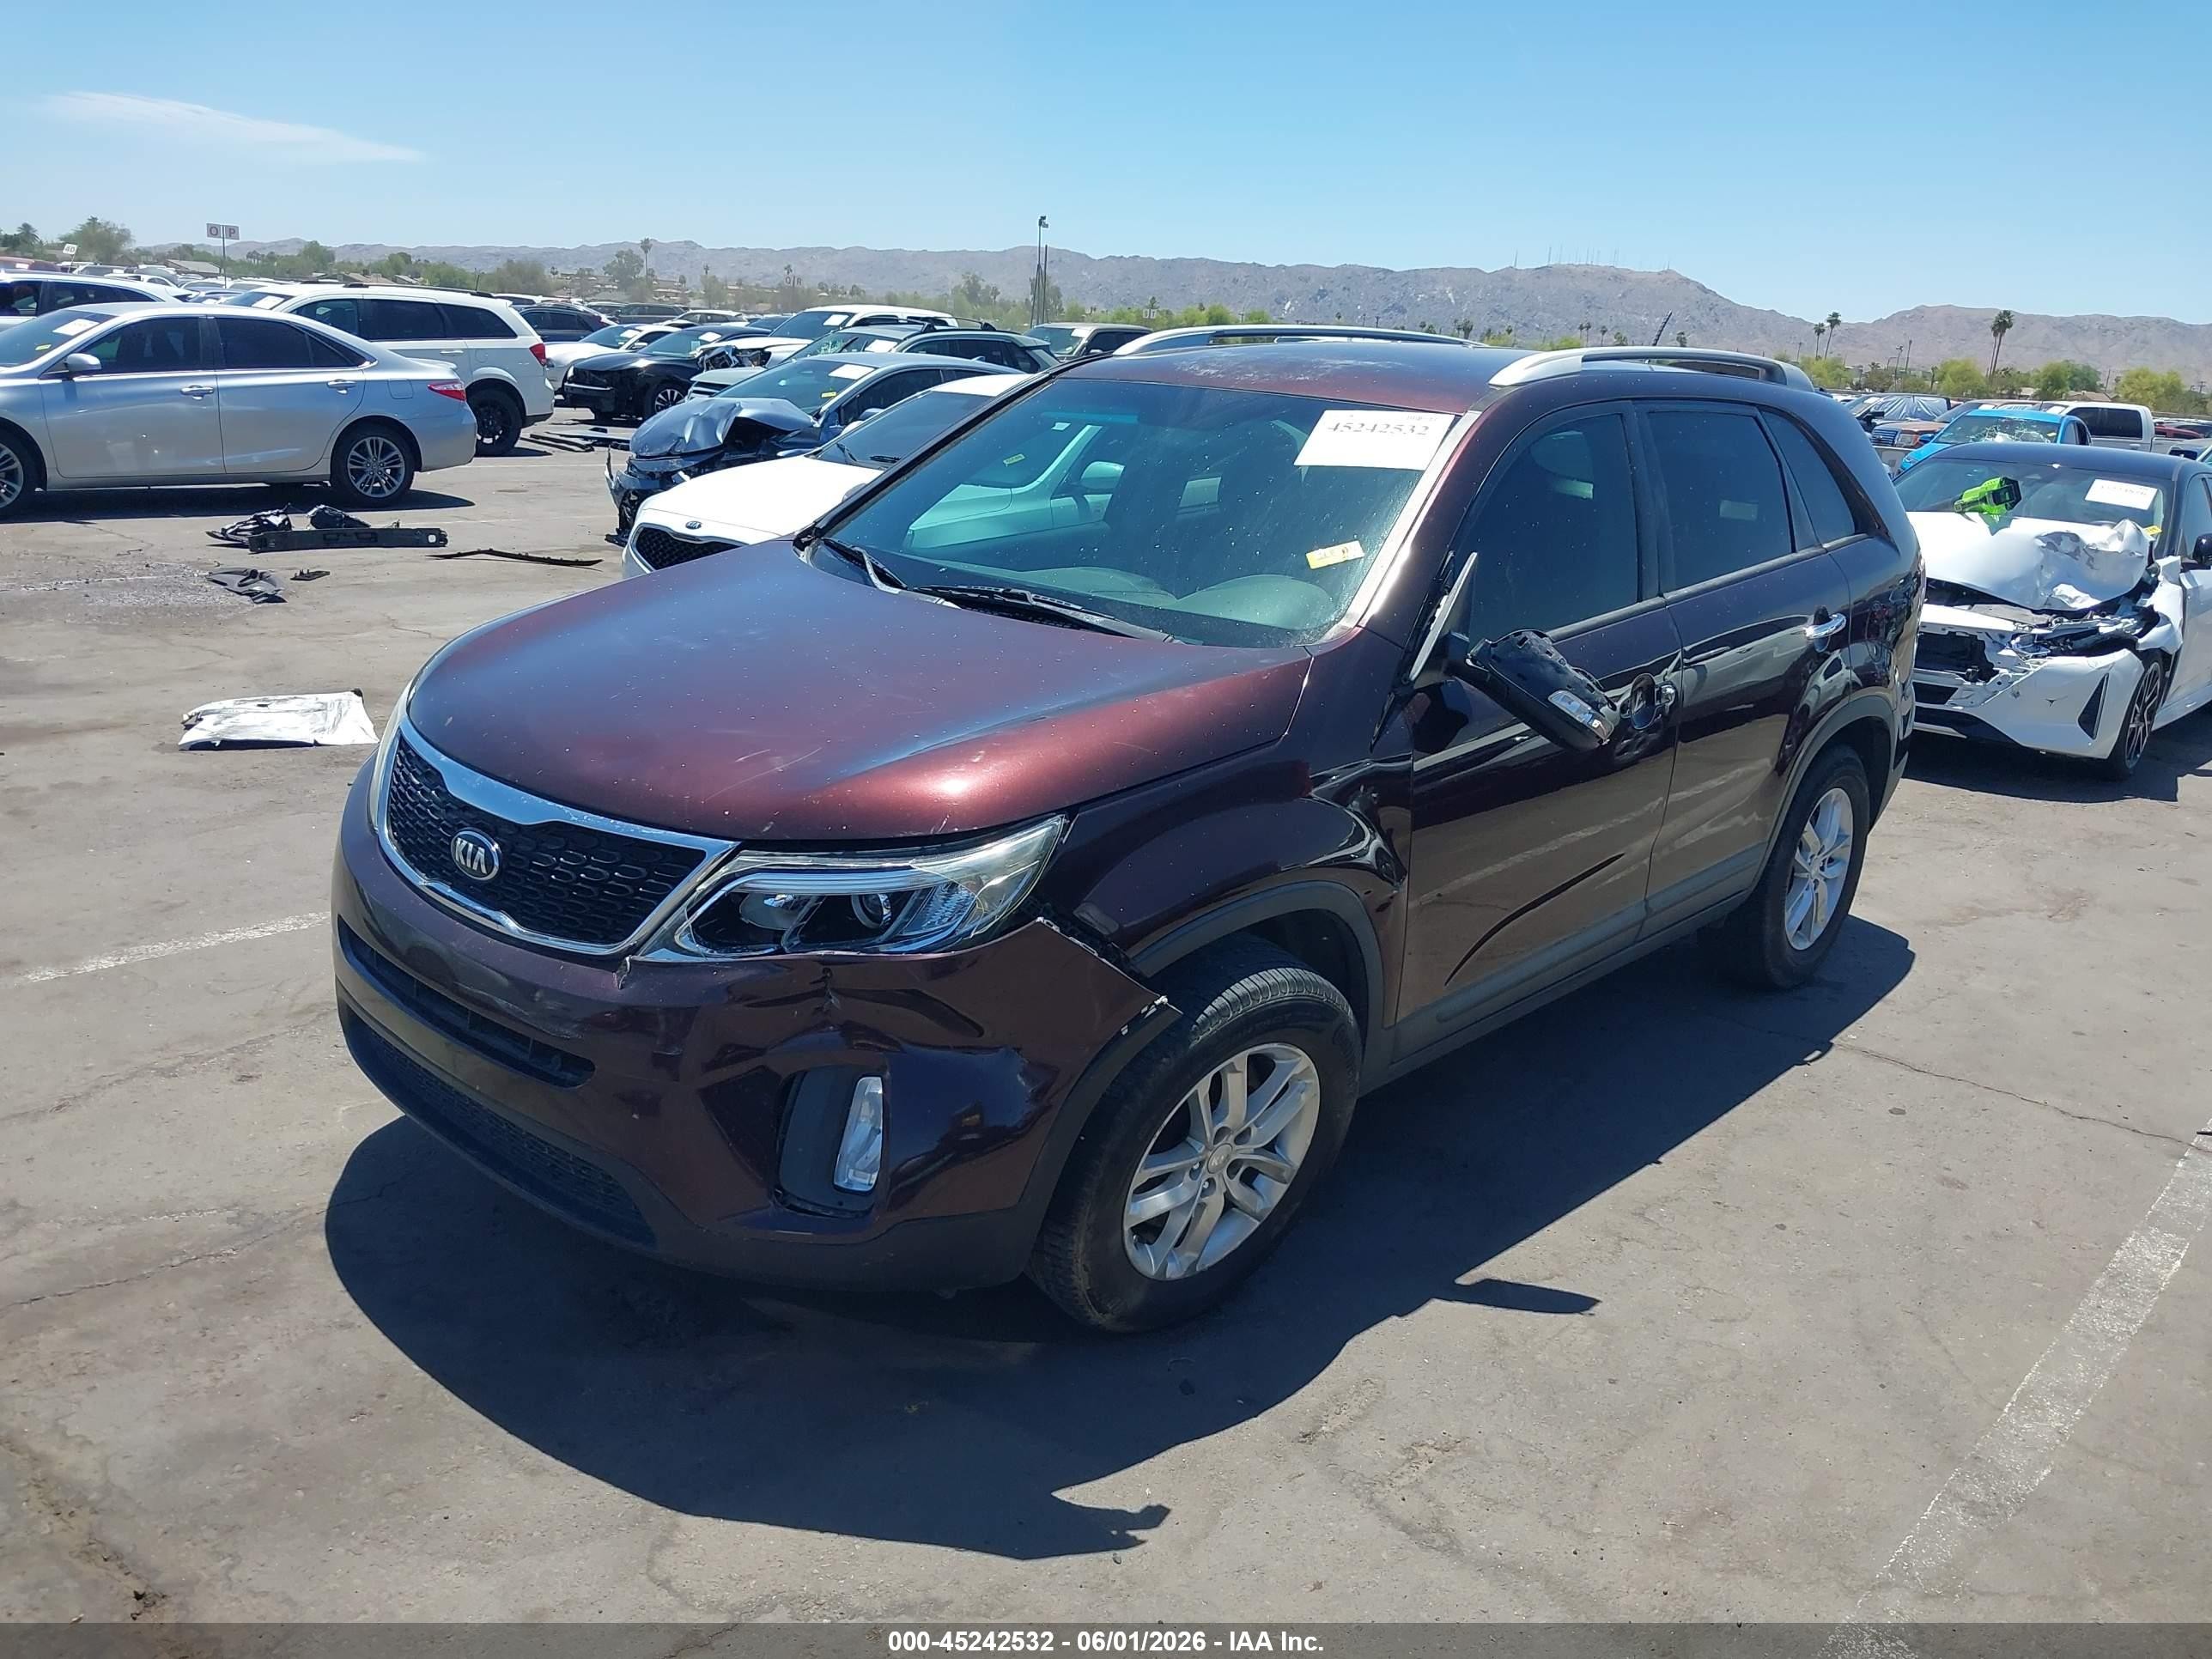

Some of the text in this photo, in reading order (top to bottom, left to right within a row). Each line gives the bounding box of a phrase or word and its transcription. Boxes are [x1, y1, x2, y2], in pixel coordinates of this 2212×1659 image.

[228, 228, 236, 238] P
[1328, 422, 1430, 435] 45242532
[455, 837, 488, 874] KIA
